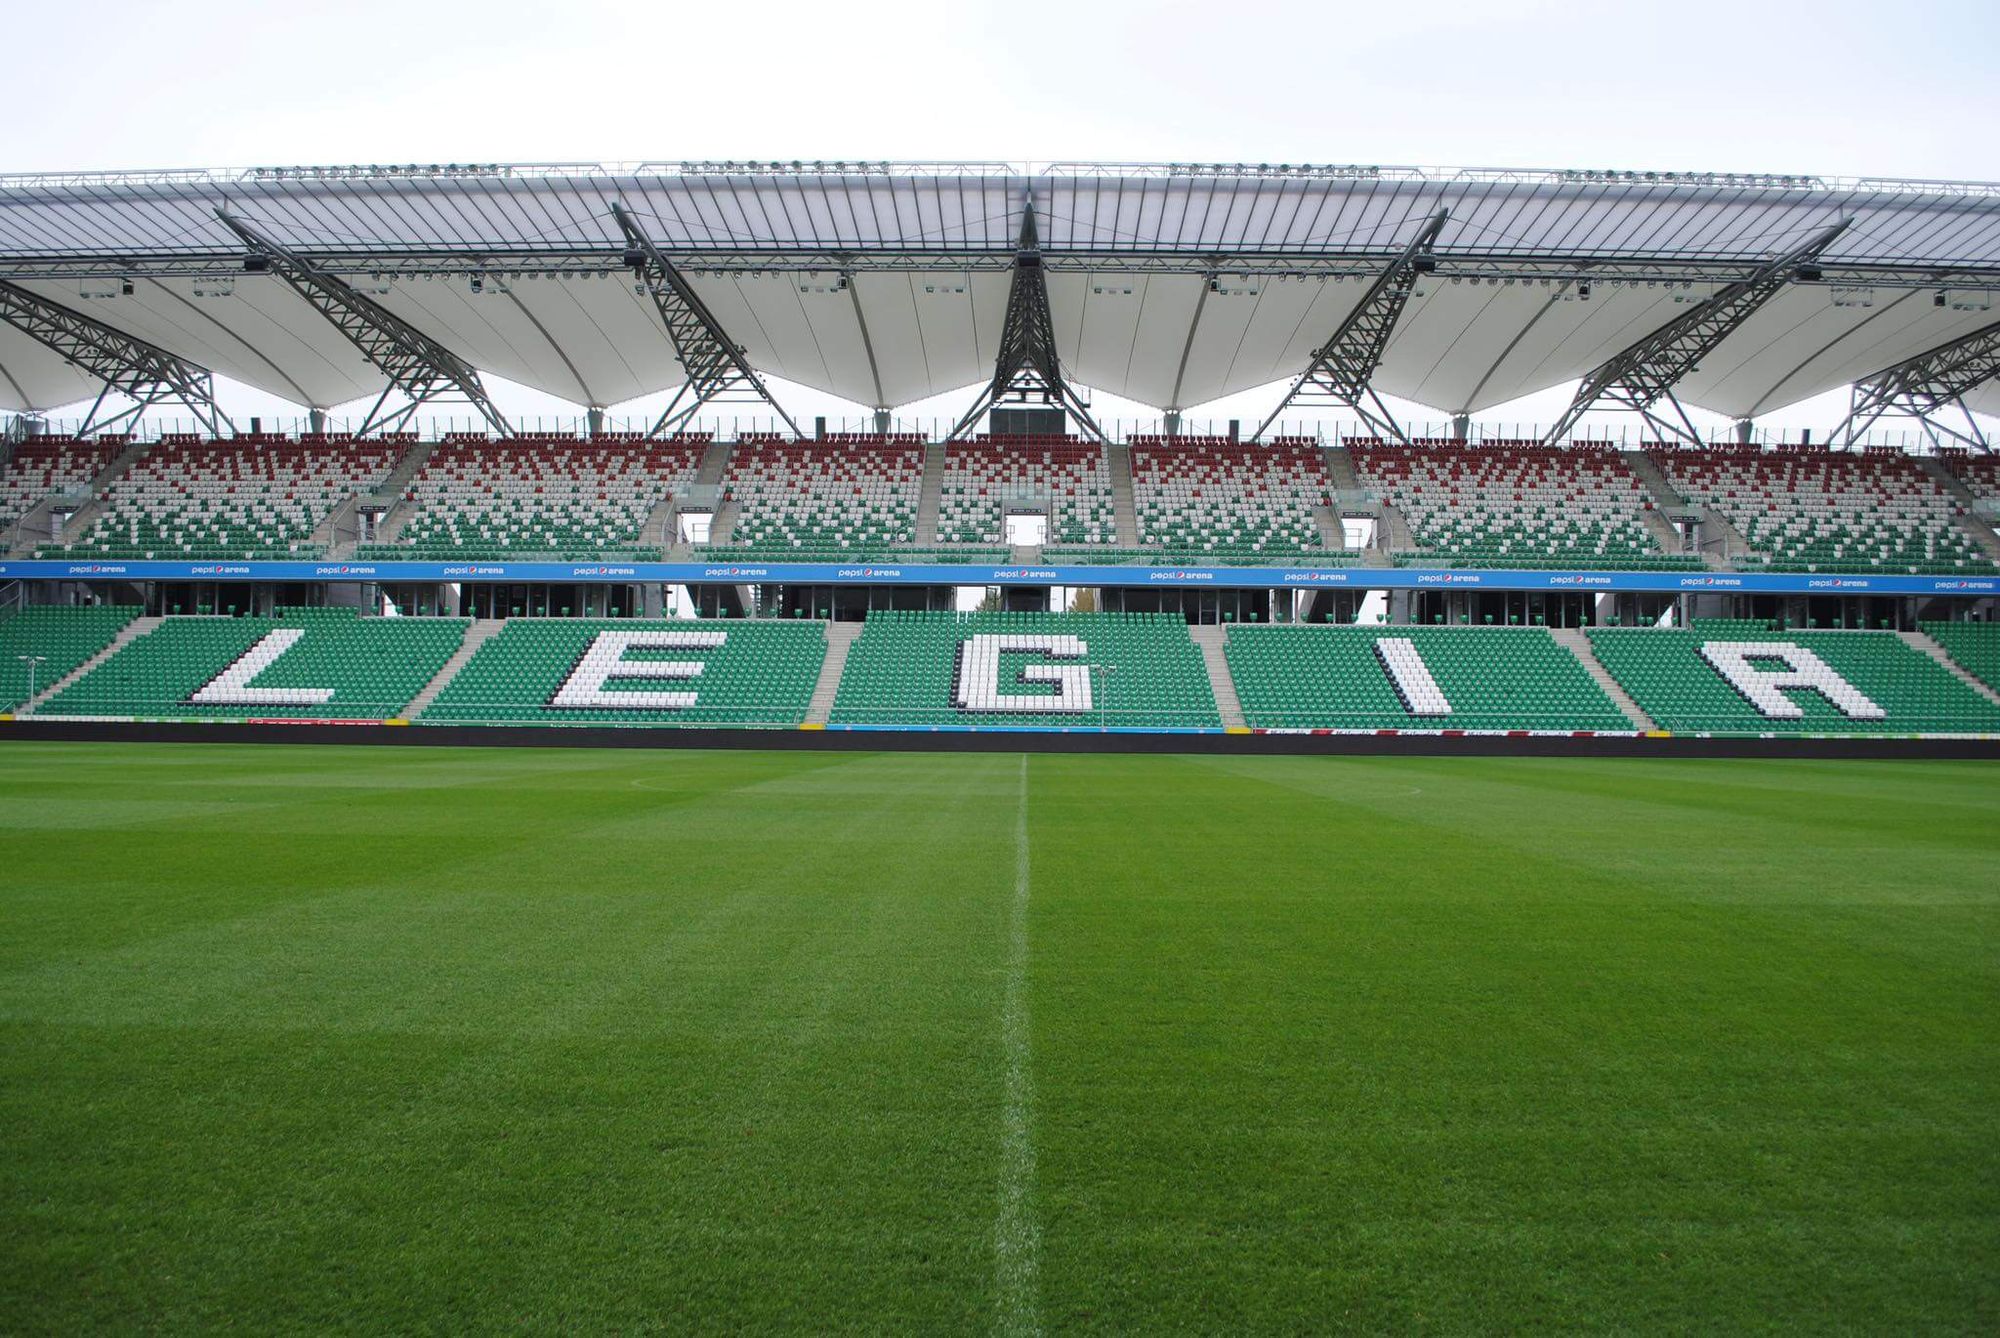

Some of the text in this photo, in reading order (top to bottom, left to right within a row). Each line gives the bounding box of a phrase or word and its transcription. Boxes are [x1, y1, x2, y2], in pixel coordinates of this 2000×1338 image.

[191, 565, 250, 575] pepsi arena
[316, 565, 376, 575] pepsi arena
[443, 565, 505, 575] pepsi arena
[573, 566, 635, 576] pepsi arena
[705, 567, 768, 577] pepsi arena
[838, 567, 901, 578] pepsi arena
[993, 569, 1057, 579] pepsi arena
[1150, 571, 1213, 581] pepsi arena
[1284, 572, 1347, 582] pepsi arena
[1417, 573, 1480, 584] pepsi arena
[1550, 575, 1612, 585] pepsi arena
[1680, 577, 1742, 587] pepsi arena
[1842, 579, 1869, 587] arena
[1966, 581, 1993, 589] arena
[184, 627, 1886, 720] LEGIA
